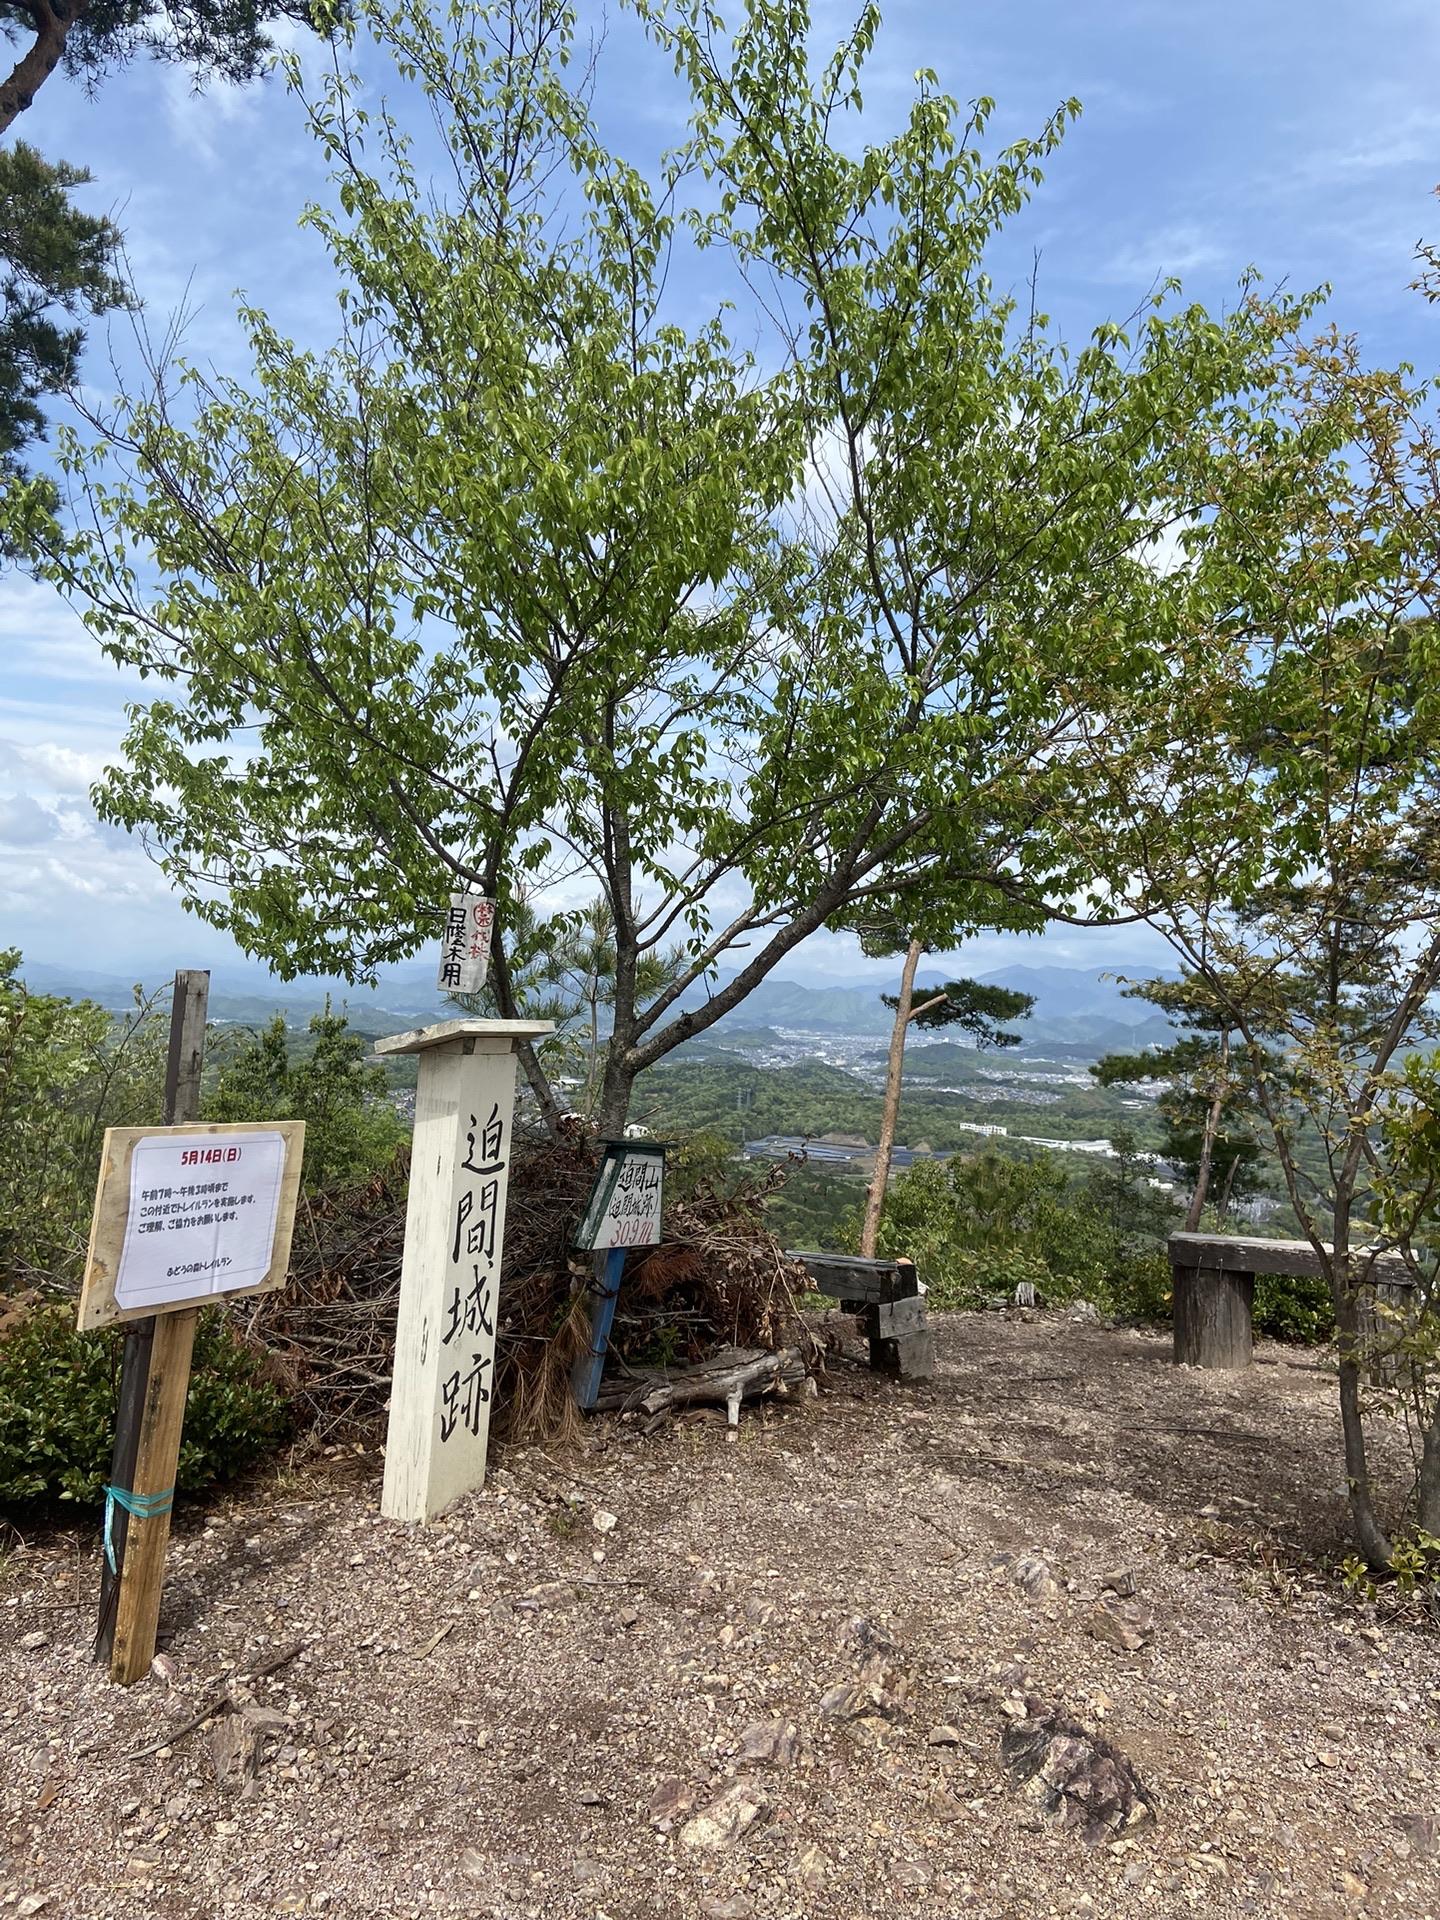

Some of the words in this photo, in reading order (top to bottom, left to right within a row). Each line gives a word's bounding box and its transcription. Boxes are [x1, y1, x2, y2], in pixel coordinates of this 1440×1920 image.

[181, 1147, 242, 1165] 5月14日(日)
[617, 1159, 659, 1193] 迫間山
[441, 1102, 506, 1443] 迫間城跡
